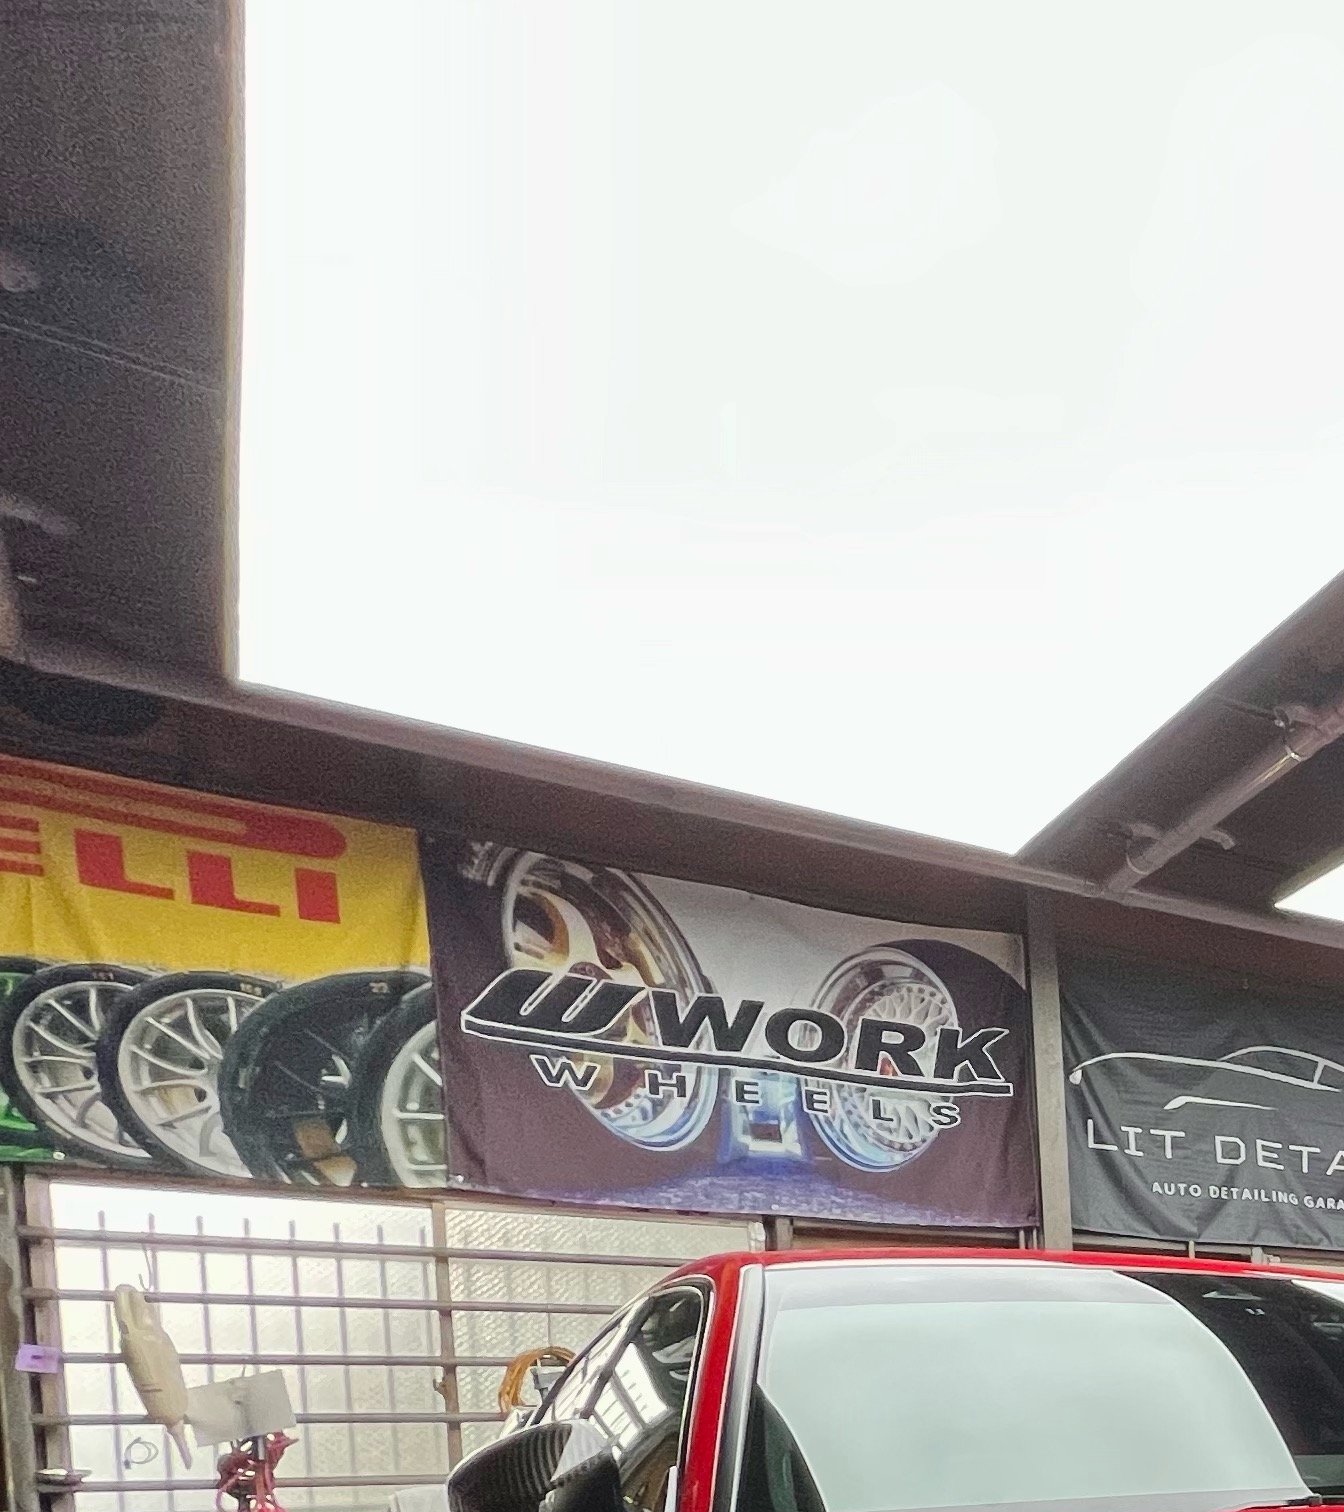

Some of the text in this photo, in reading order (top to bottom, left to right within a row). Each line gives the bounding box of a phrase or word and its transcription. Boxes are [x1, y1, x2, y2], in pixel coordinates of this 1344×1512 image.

[531, 1053, 963, 1131] WHEELS
[1087, 1118, 1185, 1159] LIT
[1151, 1181, 1202, 1198] AUTO
[1208, 1185, 1299, 1206] DETAILING
